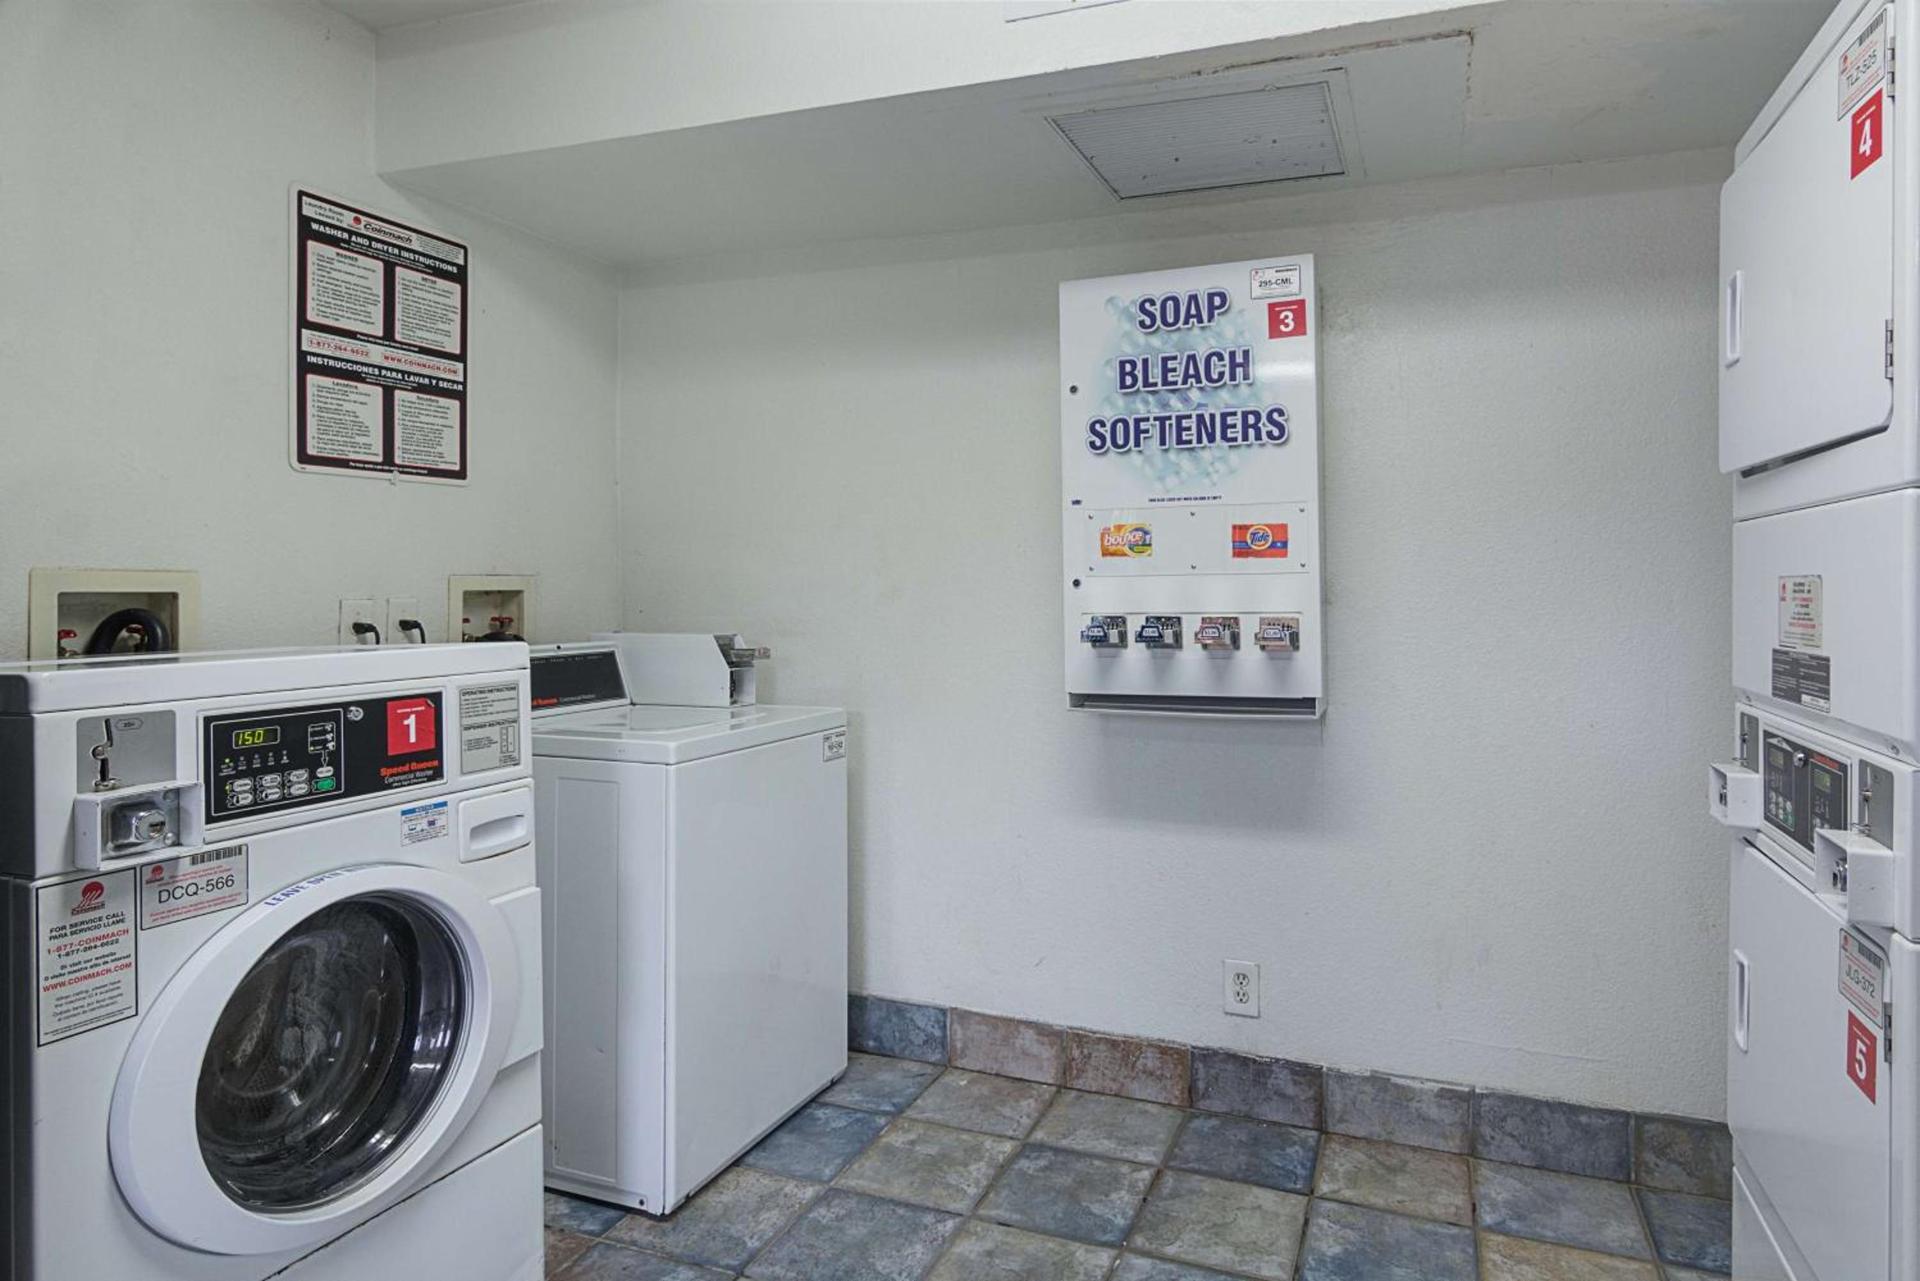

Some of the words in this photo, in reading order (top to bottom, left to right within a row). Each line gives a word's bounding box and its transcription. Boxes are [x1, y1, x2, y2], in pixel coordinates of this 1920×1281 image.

[1858, 118, 1873, 157] 4
[310, 222, 349, 240] WASHER
[351, 235, 369, 246] AND
[371, 241, 399, 254] DRYER
[401, 250, 457, 273] INSTRUCTIONS
[363, 223, 413, 244] Coinmach
[1258, 277, 1293, 288] 295-CML
[1137, 290, 1230, 332] SOAP
[1279, 310, 1295, 332] 3
[306, 355, 379, 375] INSTRUCCIONES
[381, 370, 403, 380] PARA
[404, 374, 430, 385] LAVAR
[439, 381, 464, 391] SECAR
[1118, 348, 1252, 391] BLEACH
[1088, 406, 1288, 452] SOFTENERS
[1250, 531, 1270, 545] Tide
[238, 730, 263, 745] 150
[402, 714, 417, 743] 1
[380, 763, 410, 778] Speed
[411, 760, 438, 770] Queen
[158, 874, 235, 904] DCQ-566
[263, 884, 307, 907] LEAVE
[49, 931, 67, 941] PARA
[70, 924, 101, 936] SERVICIO
[103, 917, 126, 928] LLAME
[50, 925, 66, 934] FOR
[69, 916, 103, 930] SERVICE
[105, 911, 125, 920] CALL
[48, 928, 129, 955] 1-877-COINMACH
[43, 962, 133, 993] WWW.COINMACH.COM
[1855, 1038, 1867, 1080] 5
